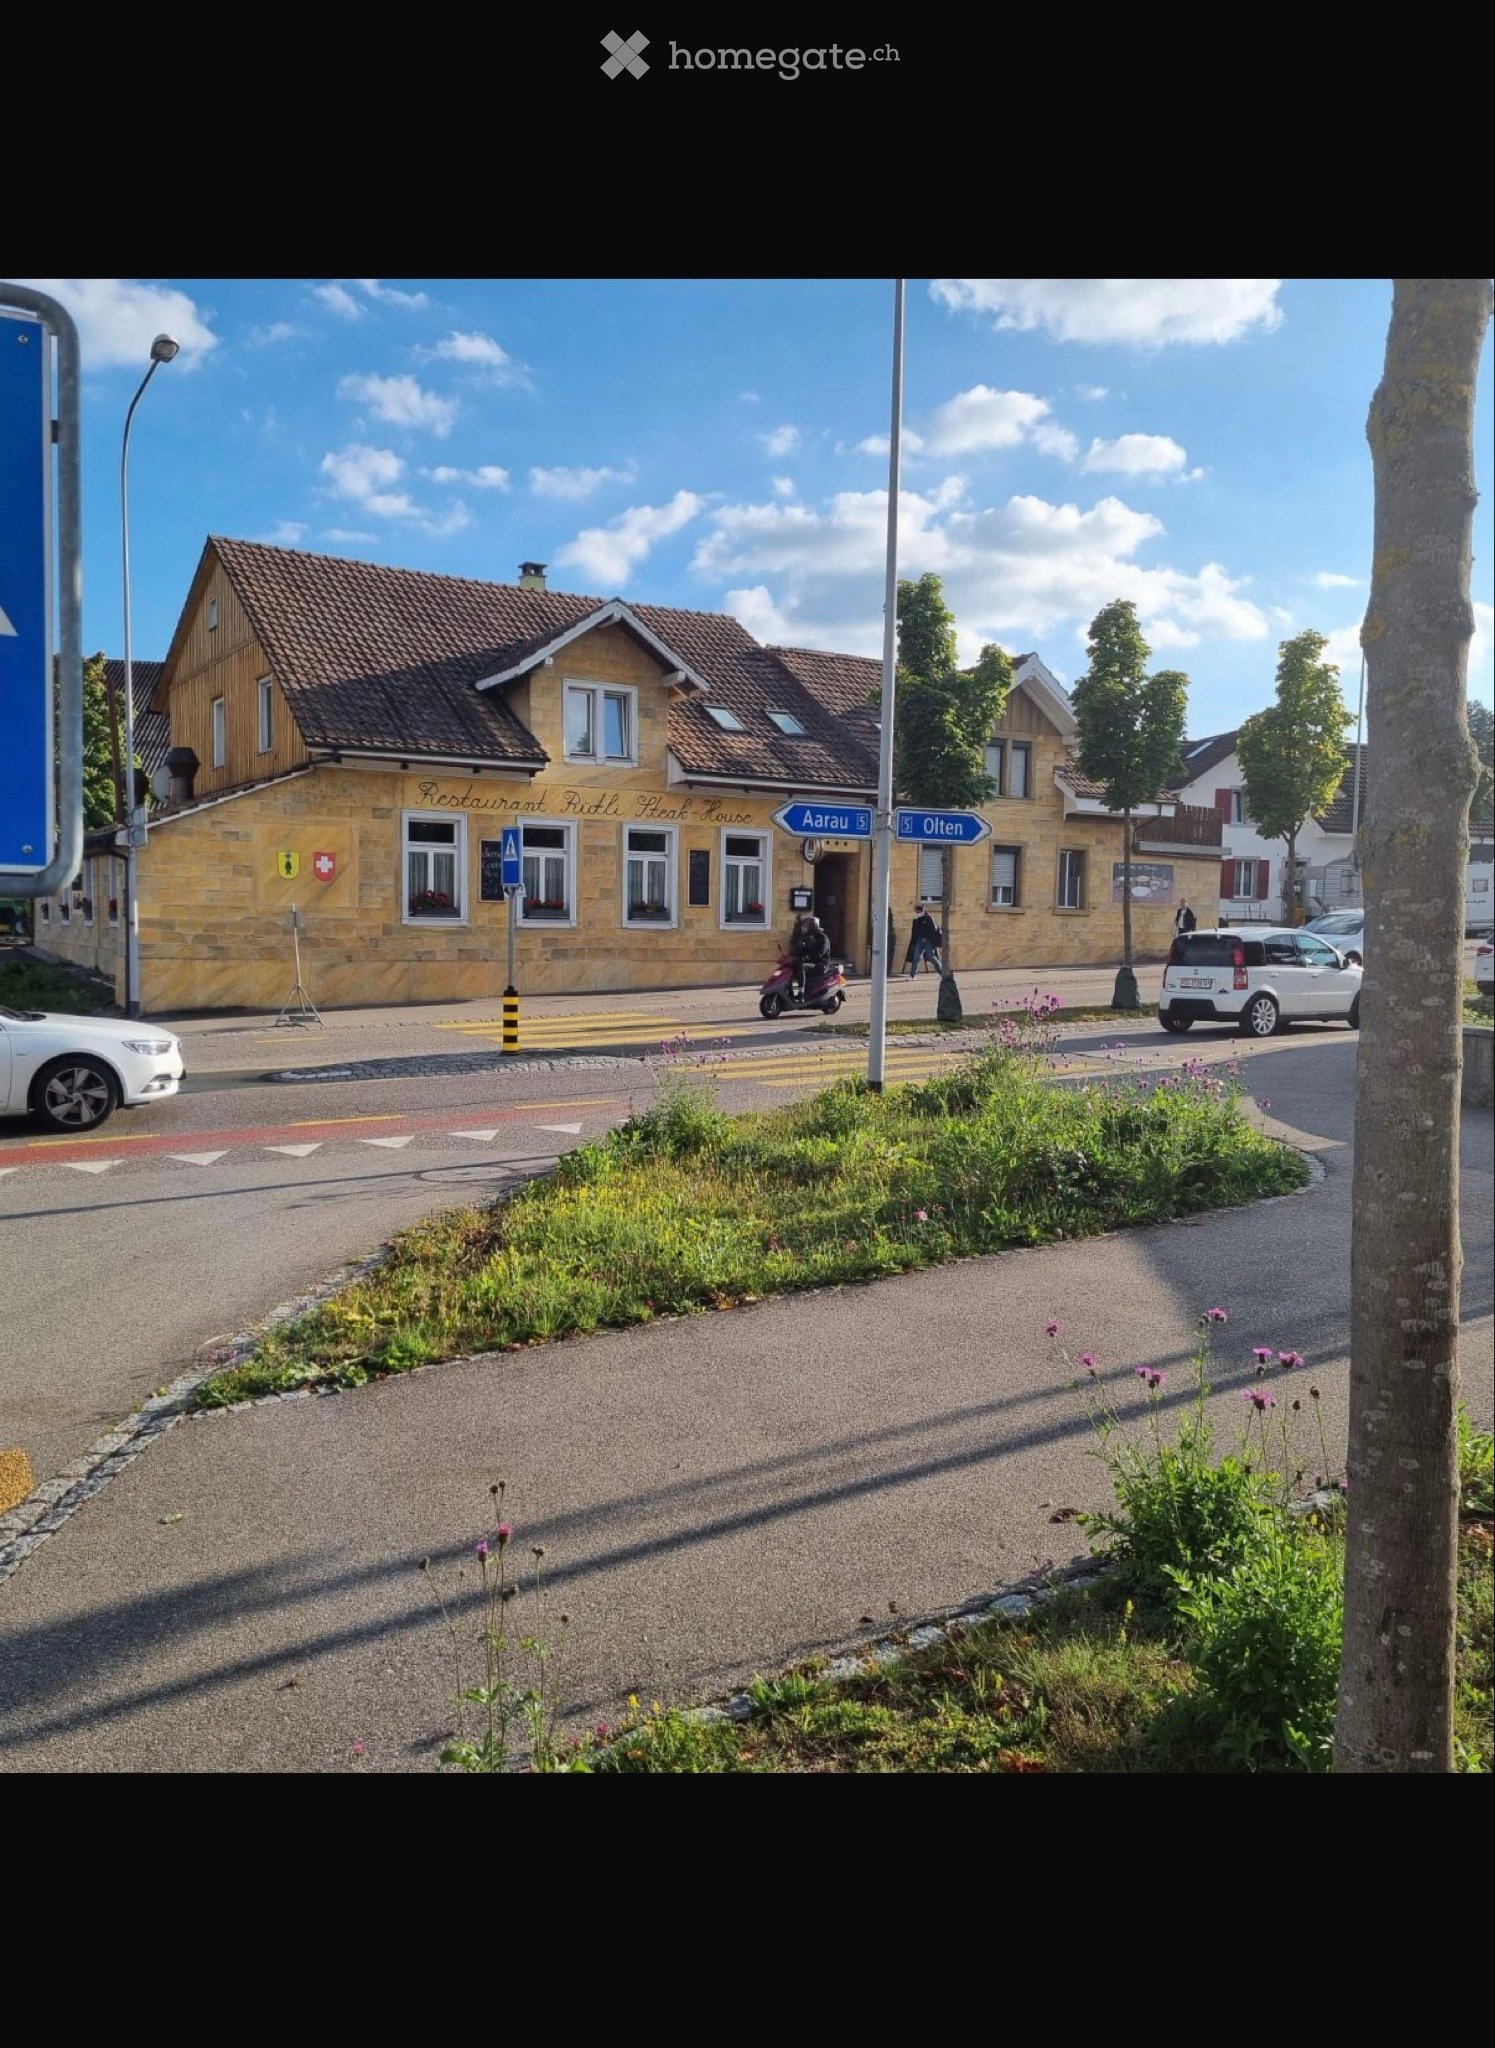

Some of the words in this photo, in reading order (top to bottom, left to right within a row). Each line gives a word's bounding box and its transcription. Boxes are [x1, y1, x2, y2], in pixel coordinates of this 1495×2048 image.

[415, 781, 547, 812] Restaurant
[560, 790, 624, 816] Rütli
[635, 794, 754, 824] Steak-House
[802, 810, 849, 829] Aarau
[858, 815, 866, 829] 5
[903, 818, 911, 832] 5
[923, 817, 964, 836] Olten
